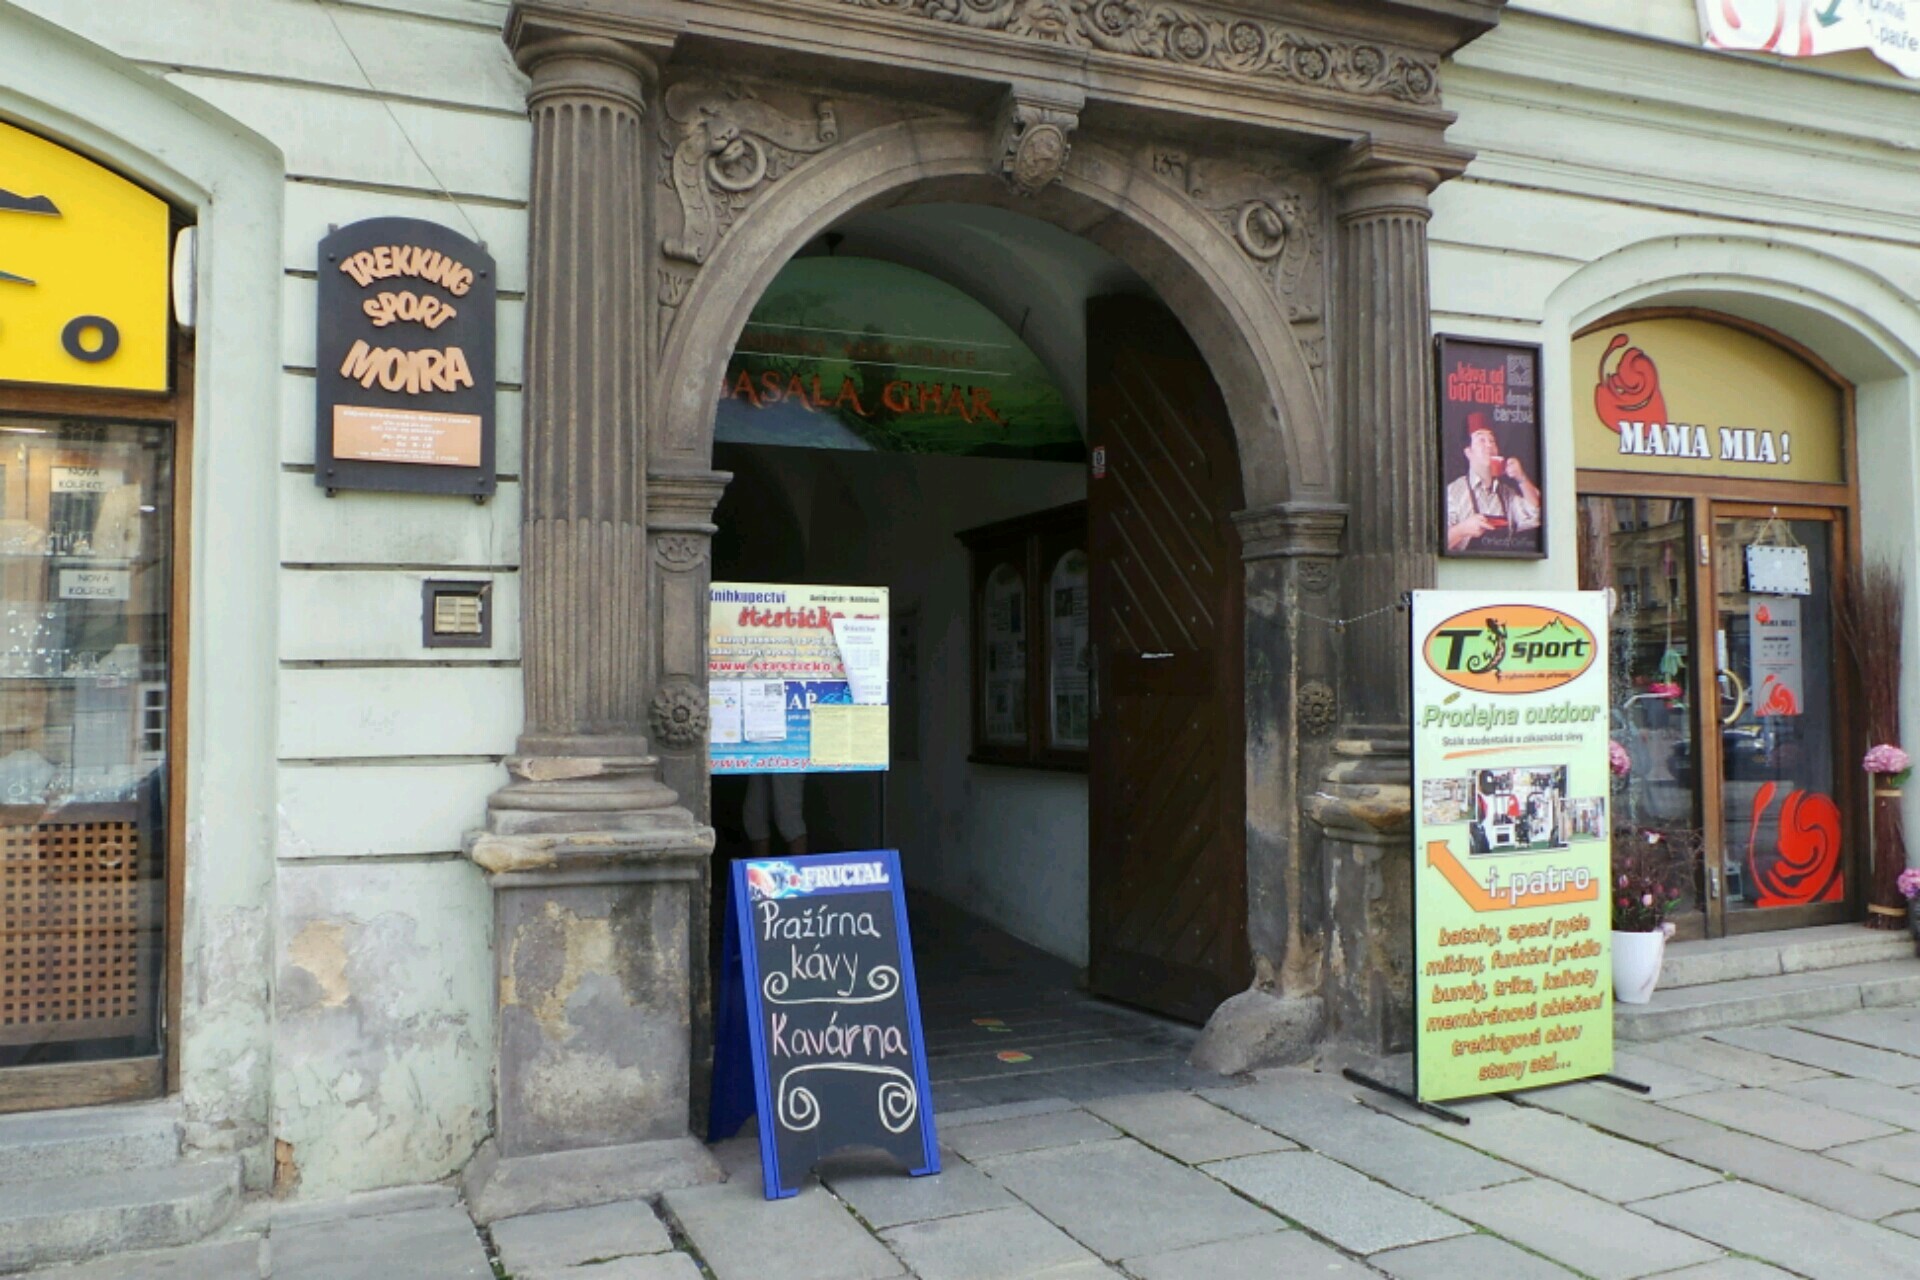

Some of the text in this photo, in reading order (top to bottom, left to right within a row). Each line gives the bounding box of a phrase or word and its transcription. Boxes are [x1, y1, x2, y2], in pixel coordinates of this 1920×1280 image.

[340, 245, 474, 296] TREKKING
[363, 290, 457, 329] SPORT
[340, 339, 474, 394] MOIRA
[879, 379, 1006, 428] GHAR
[1618, 420, 1791, 464] MAMA MIA!
[1511, 640, 1591, 664] sport
[1422, 701, 1601, 731] Prodejna outdoor
[800, 861, 890, 889] FRUCTAL
[757, 899, 882, 941] Pražírna
[791, 943, 859, 997] kávy
[771, 1010, 908, 1060] Kavárna
